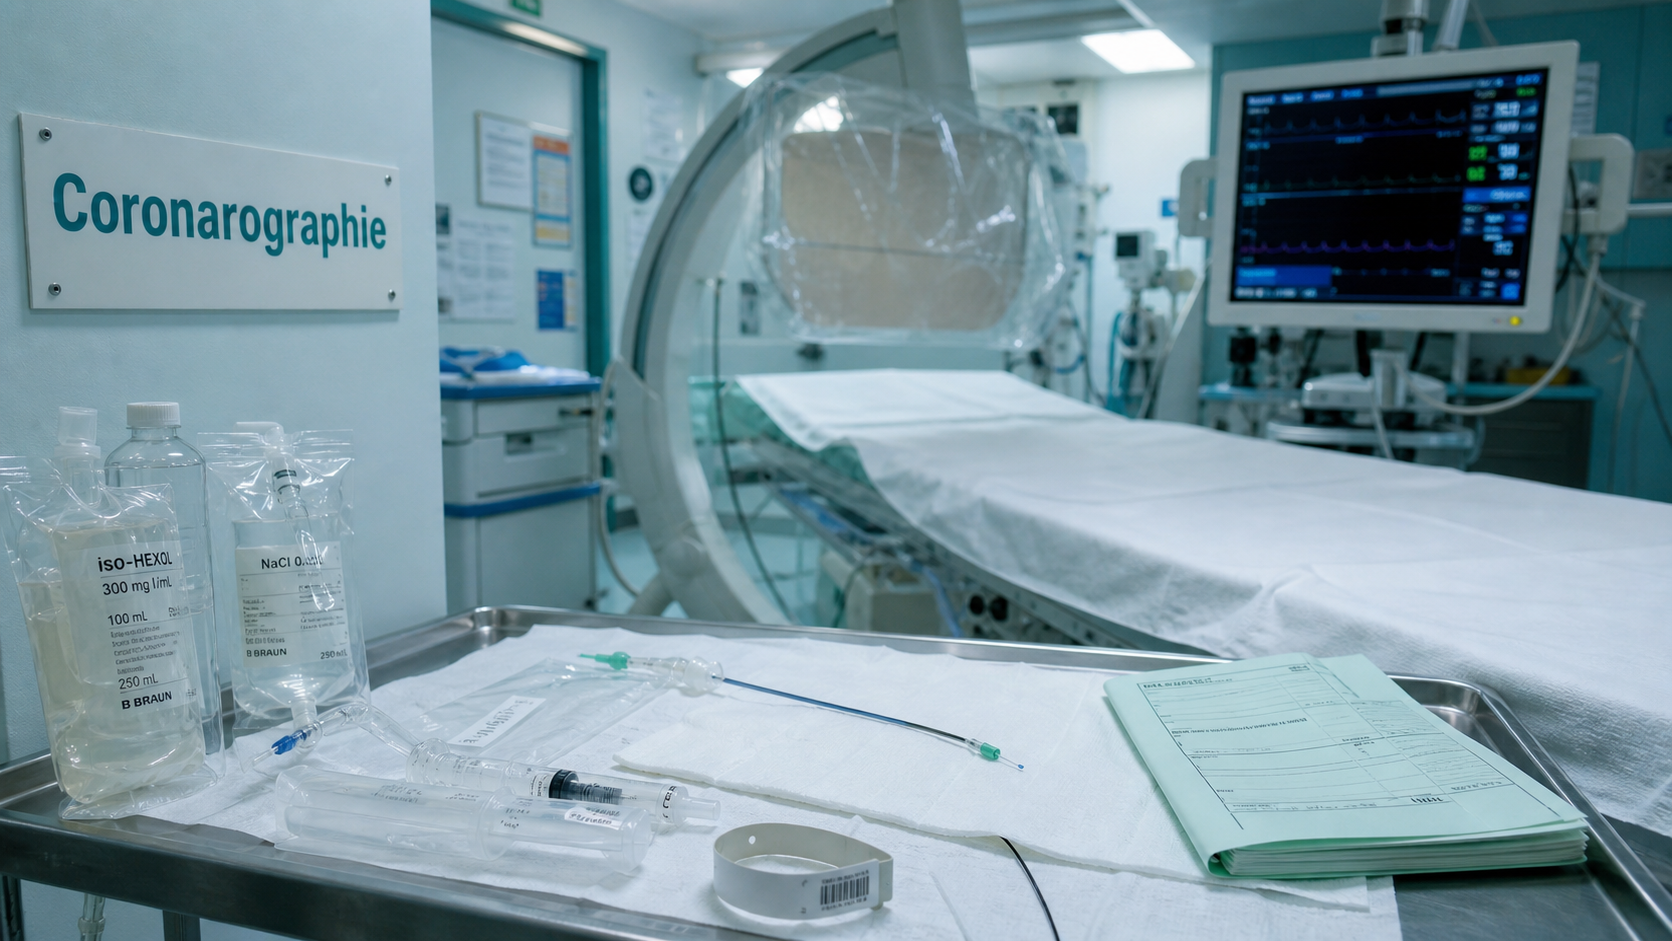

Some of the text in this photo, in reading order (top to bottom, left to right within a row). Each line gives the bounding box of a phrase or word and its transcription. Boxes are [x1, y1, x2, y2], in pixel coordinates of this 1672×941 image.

[53, 173, 386, 257] Coronarographie
[98, 551, 172, 572] iso-HEXOL
[261, 557, 291, 569] NaCl
[102, 581, 128, 596] 300
[132, 581, 150, 594] mg
[108, 611, 148, 626] 100 mL
[253, 648, 287, 657] BRAUN
[320, 650, 335, 660] 250
[118, 673, 158, 690] 250 mL
[121, 699, 131, 710] B
[133, 691, 172, 708] BRAUN
